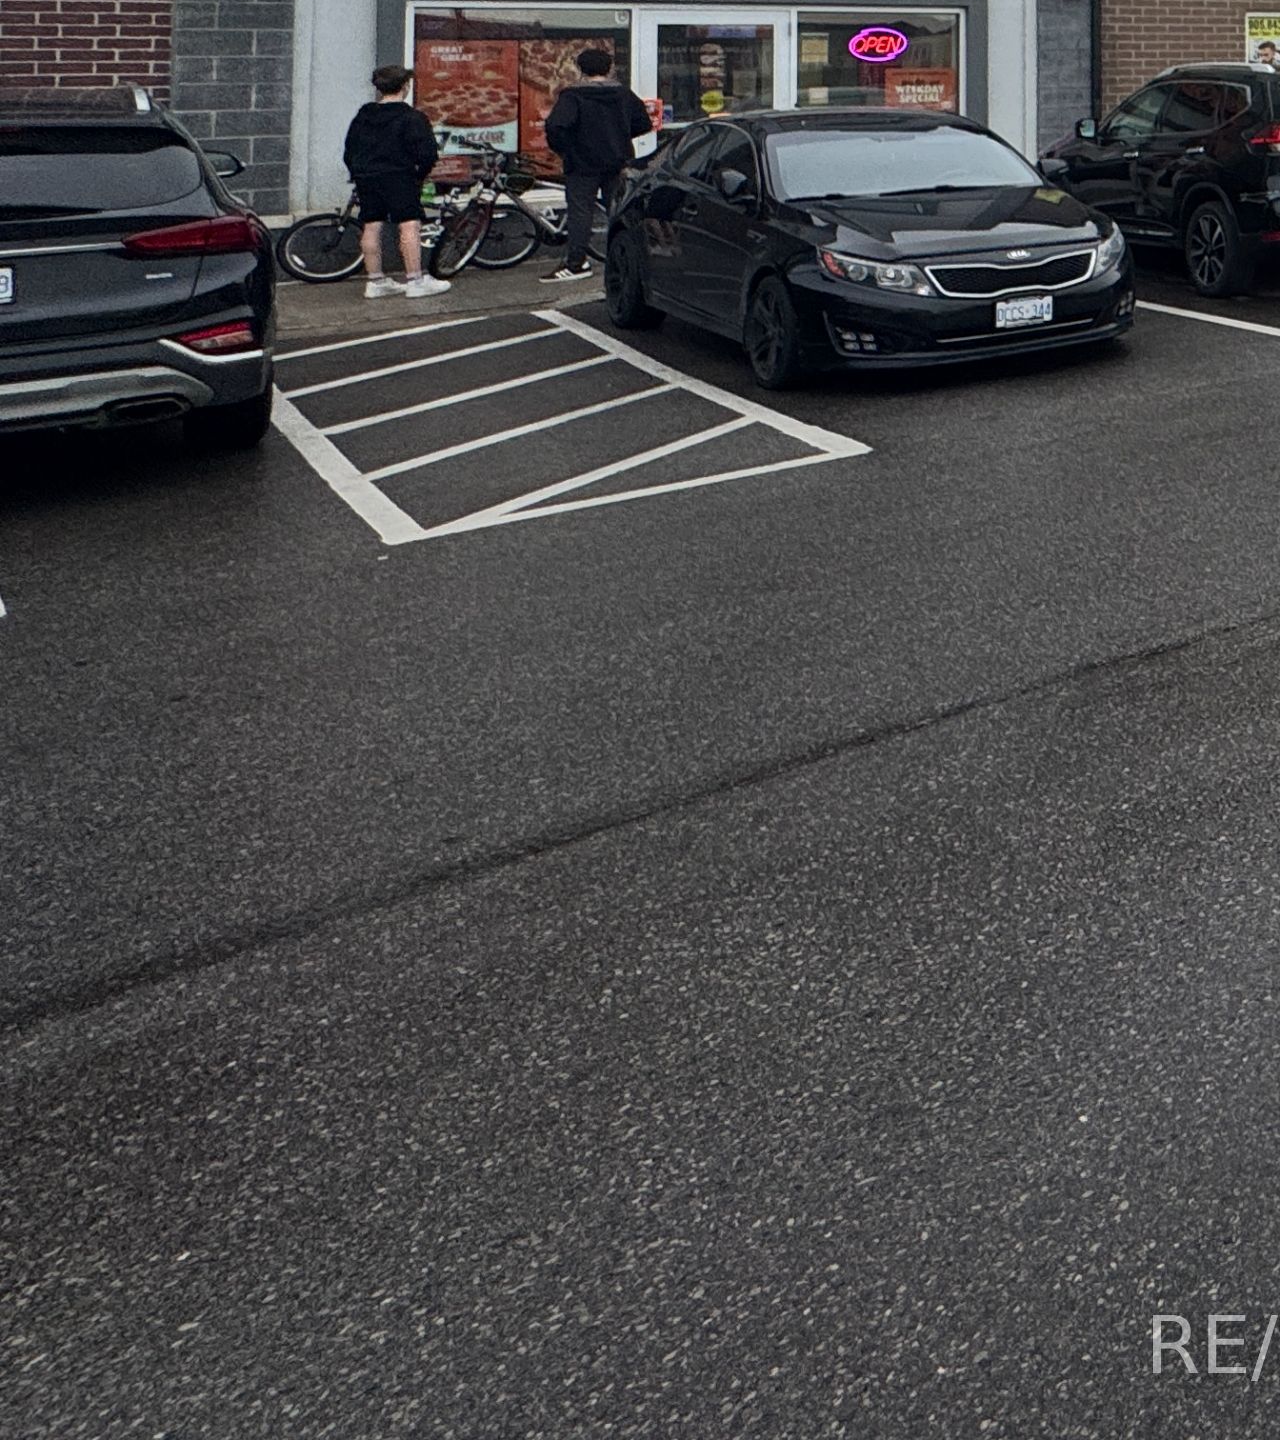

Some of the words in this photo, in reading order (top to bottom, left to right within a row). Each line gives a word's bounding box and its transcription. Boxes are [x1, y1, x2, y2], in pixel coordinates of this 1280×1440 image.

[854, 35, 901, 54] OPEN
[431, 46, 464, 54] GREAT
[895, 84, 945, 94] WEEKDAY
[899, 94, 940, 103] SPECIAL
